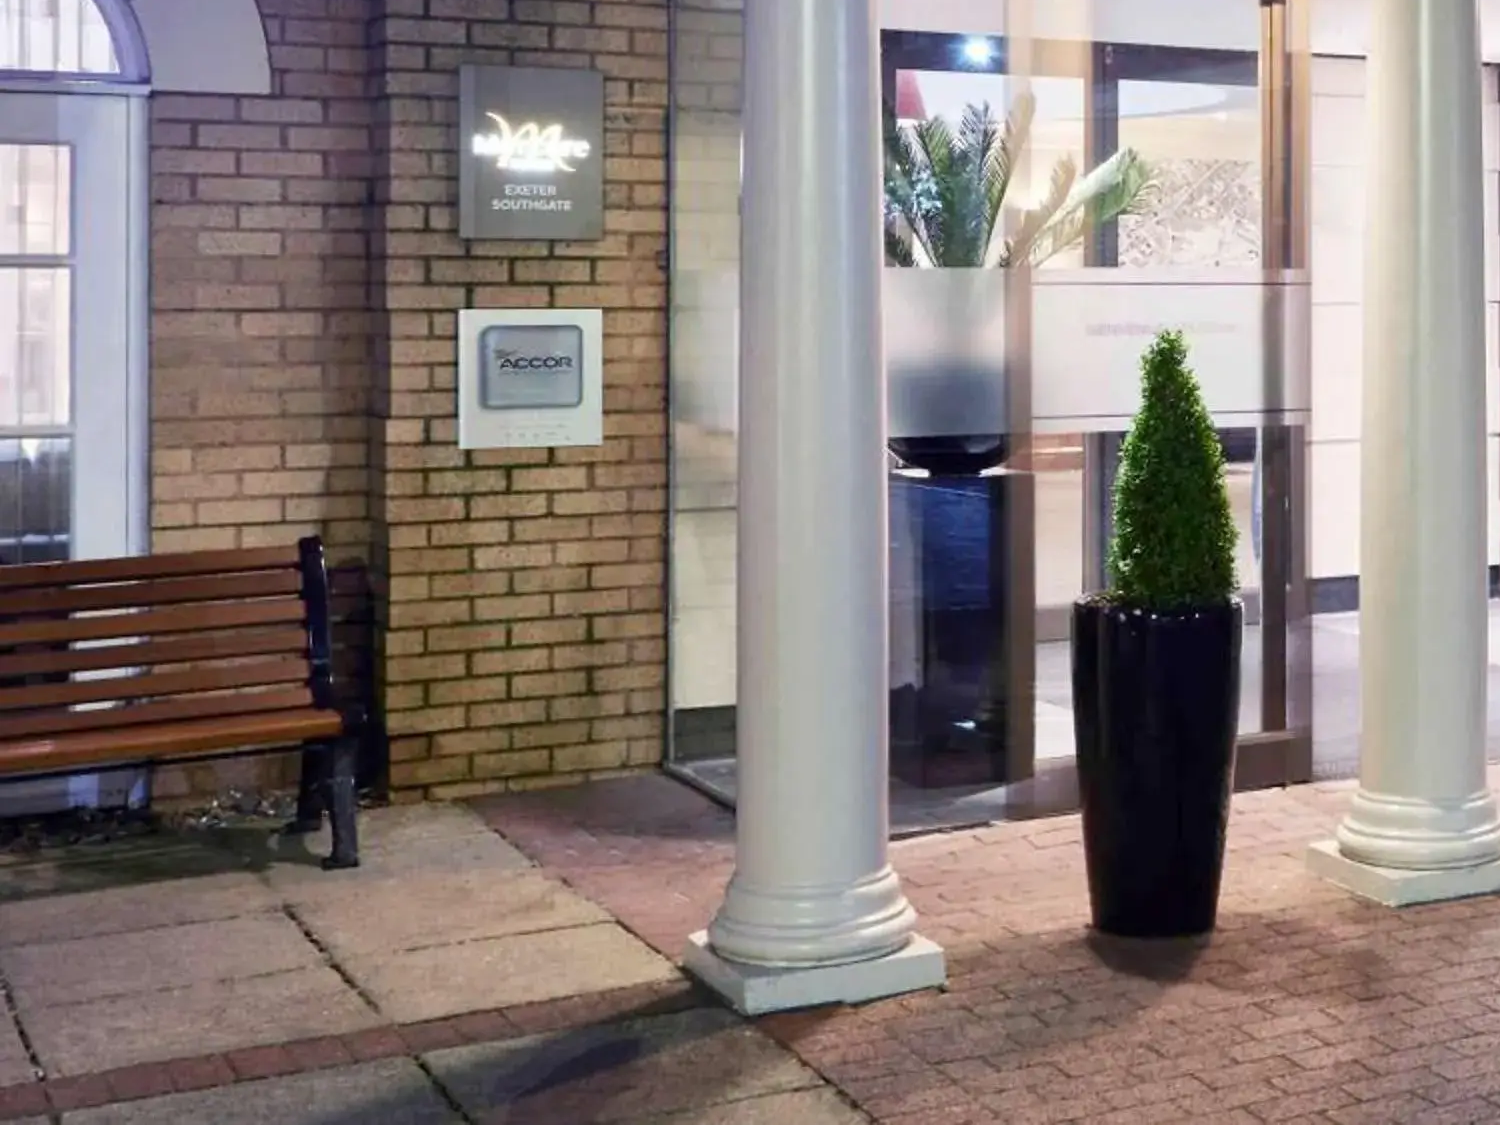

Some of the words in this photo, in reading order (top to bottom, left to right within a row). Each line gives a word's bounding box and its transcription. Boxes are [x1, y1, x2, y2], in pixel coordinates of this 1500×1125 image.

[504, 184, 557, 196] EXETER
[491, 198, 573, 212] SOUTHGATE
[499, 356, 574, 369] ACCOR
